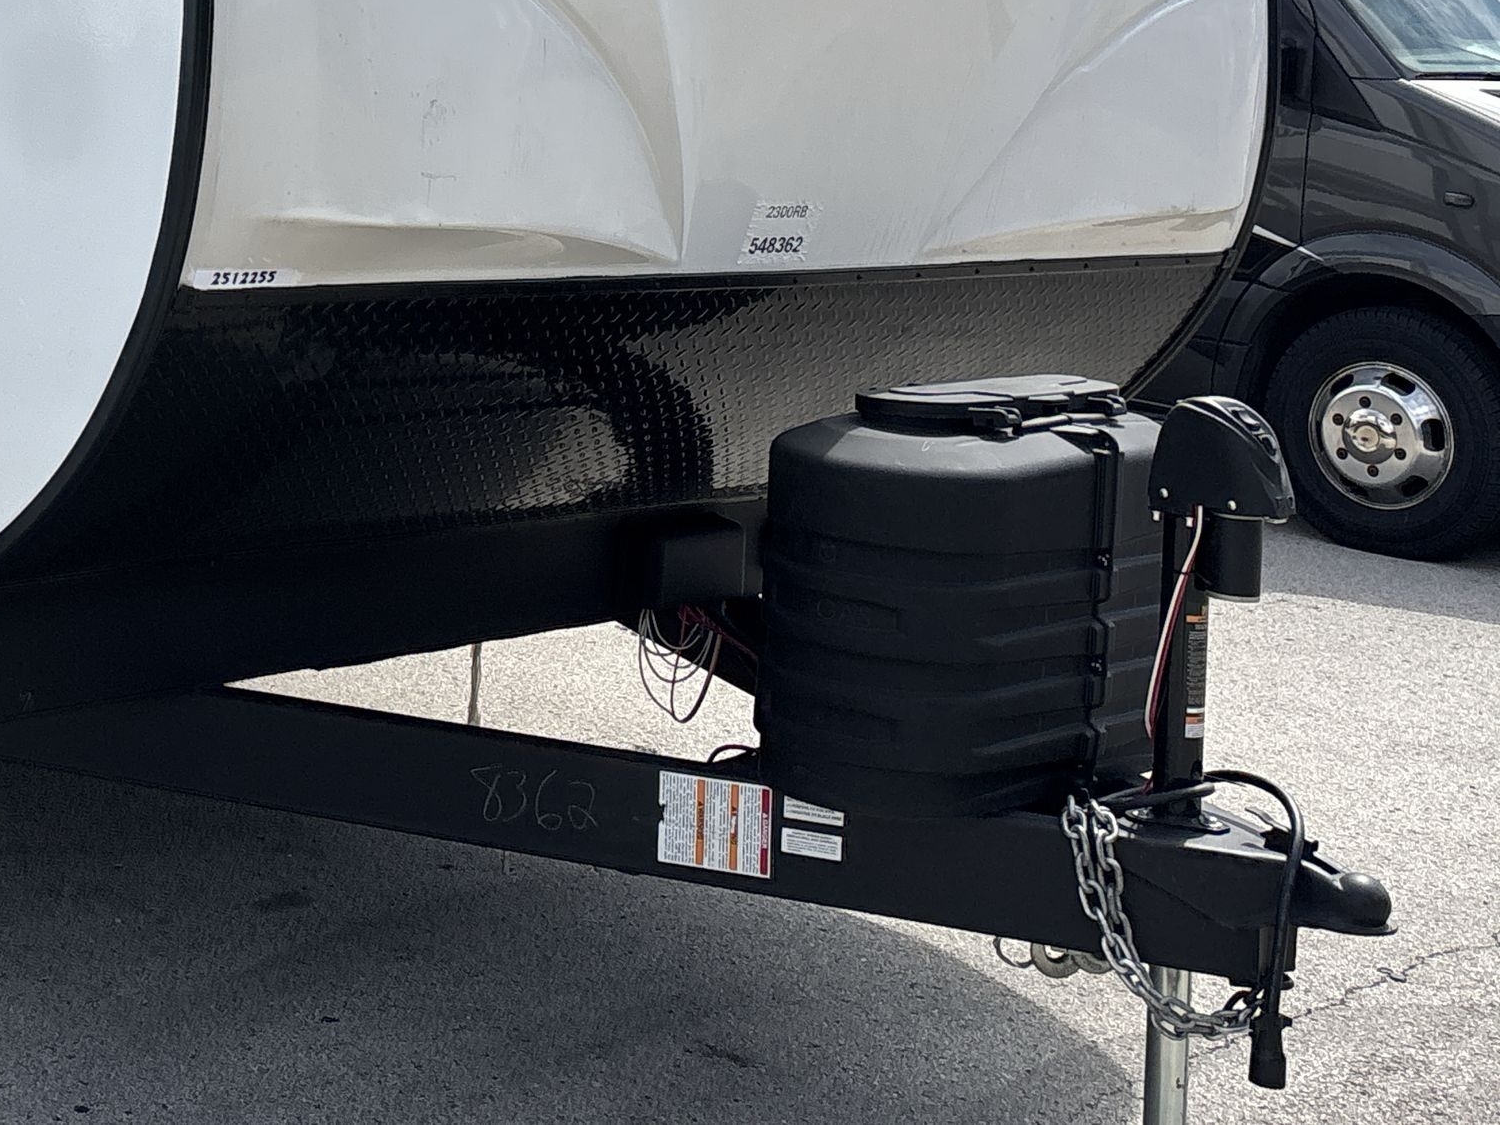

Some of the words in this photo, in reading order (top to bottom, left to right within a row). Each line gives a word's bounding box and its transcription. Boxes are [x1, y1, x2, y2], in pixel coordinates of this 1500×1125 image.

[748, 236, 804, 255] 548362
[210, 271, 277, 286] 2512255
[470, 763, 599, 831] 8362
